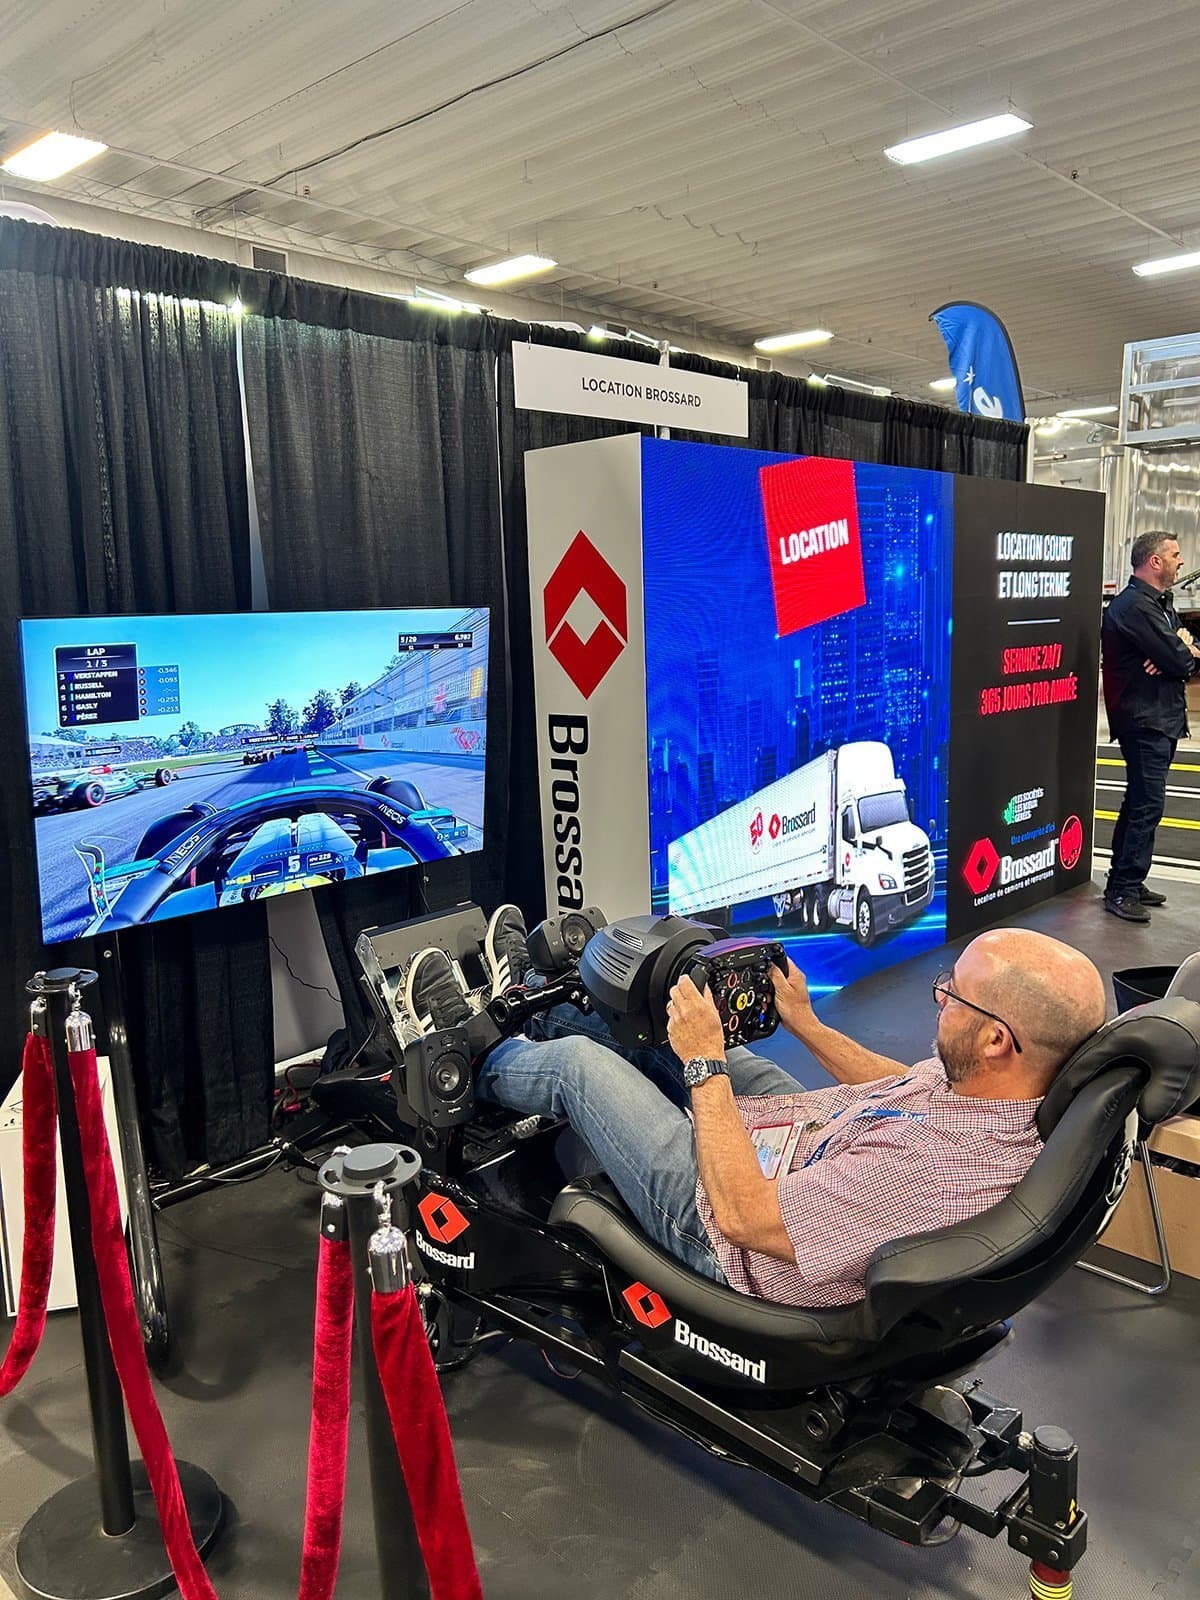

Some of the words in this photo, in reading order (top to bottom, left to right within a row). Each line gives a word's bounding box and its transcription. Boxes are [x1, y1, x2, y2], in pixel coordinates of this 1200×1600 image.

[582, 377, 642, 399] LOCATION
[646, 387, 701, 407] BROSSARD
[779, 518, 849, 565] LOCATION
[997, 532, 1042, 561] LOCATION
[1043, 534, 1074, 562] COURT
[998, 571, 1012, 599] ET
[1013, 571, 1039, 598] LONG
[1039, 571, 1071, 598] TERME
[87, 648, 105, 656] LAP
[1003, 646, 1041, 674] SERVICE
[1042, 643, 1063, 671] 24/7
[74, 671, 118, 680] VERSTAPPEN
[74, 682, 104, 690] RUSSELL
[75, 691, 112, 701] HAMILTON
[76, 703, 98, 711] GASLY
[981, 687, 1001, 715] 365
[1002, 683, 1031, 711] JOURS
[1032, 680, 1049, 707] PAR
[1050, 672, 1078, 703] ANNÉE
[378, 803, 407, 824] INEOS
[548, 713, 590, 916] Brossa
[782, 801, 816, 836] Brossard
[163, 834, 200, 866] INEOS
[288, 855, 300, 873] 5
[1000, 840, 1055, 885] Brossard
[415, 1229, 475, 1270] Brossard
[674, 1318, 766, 1385] Brossard
